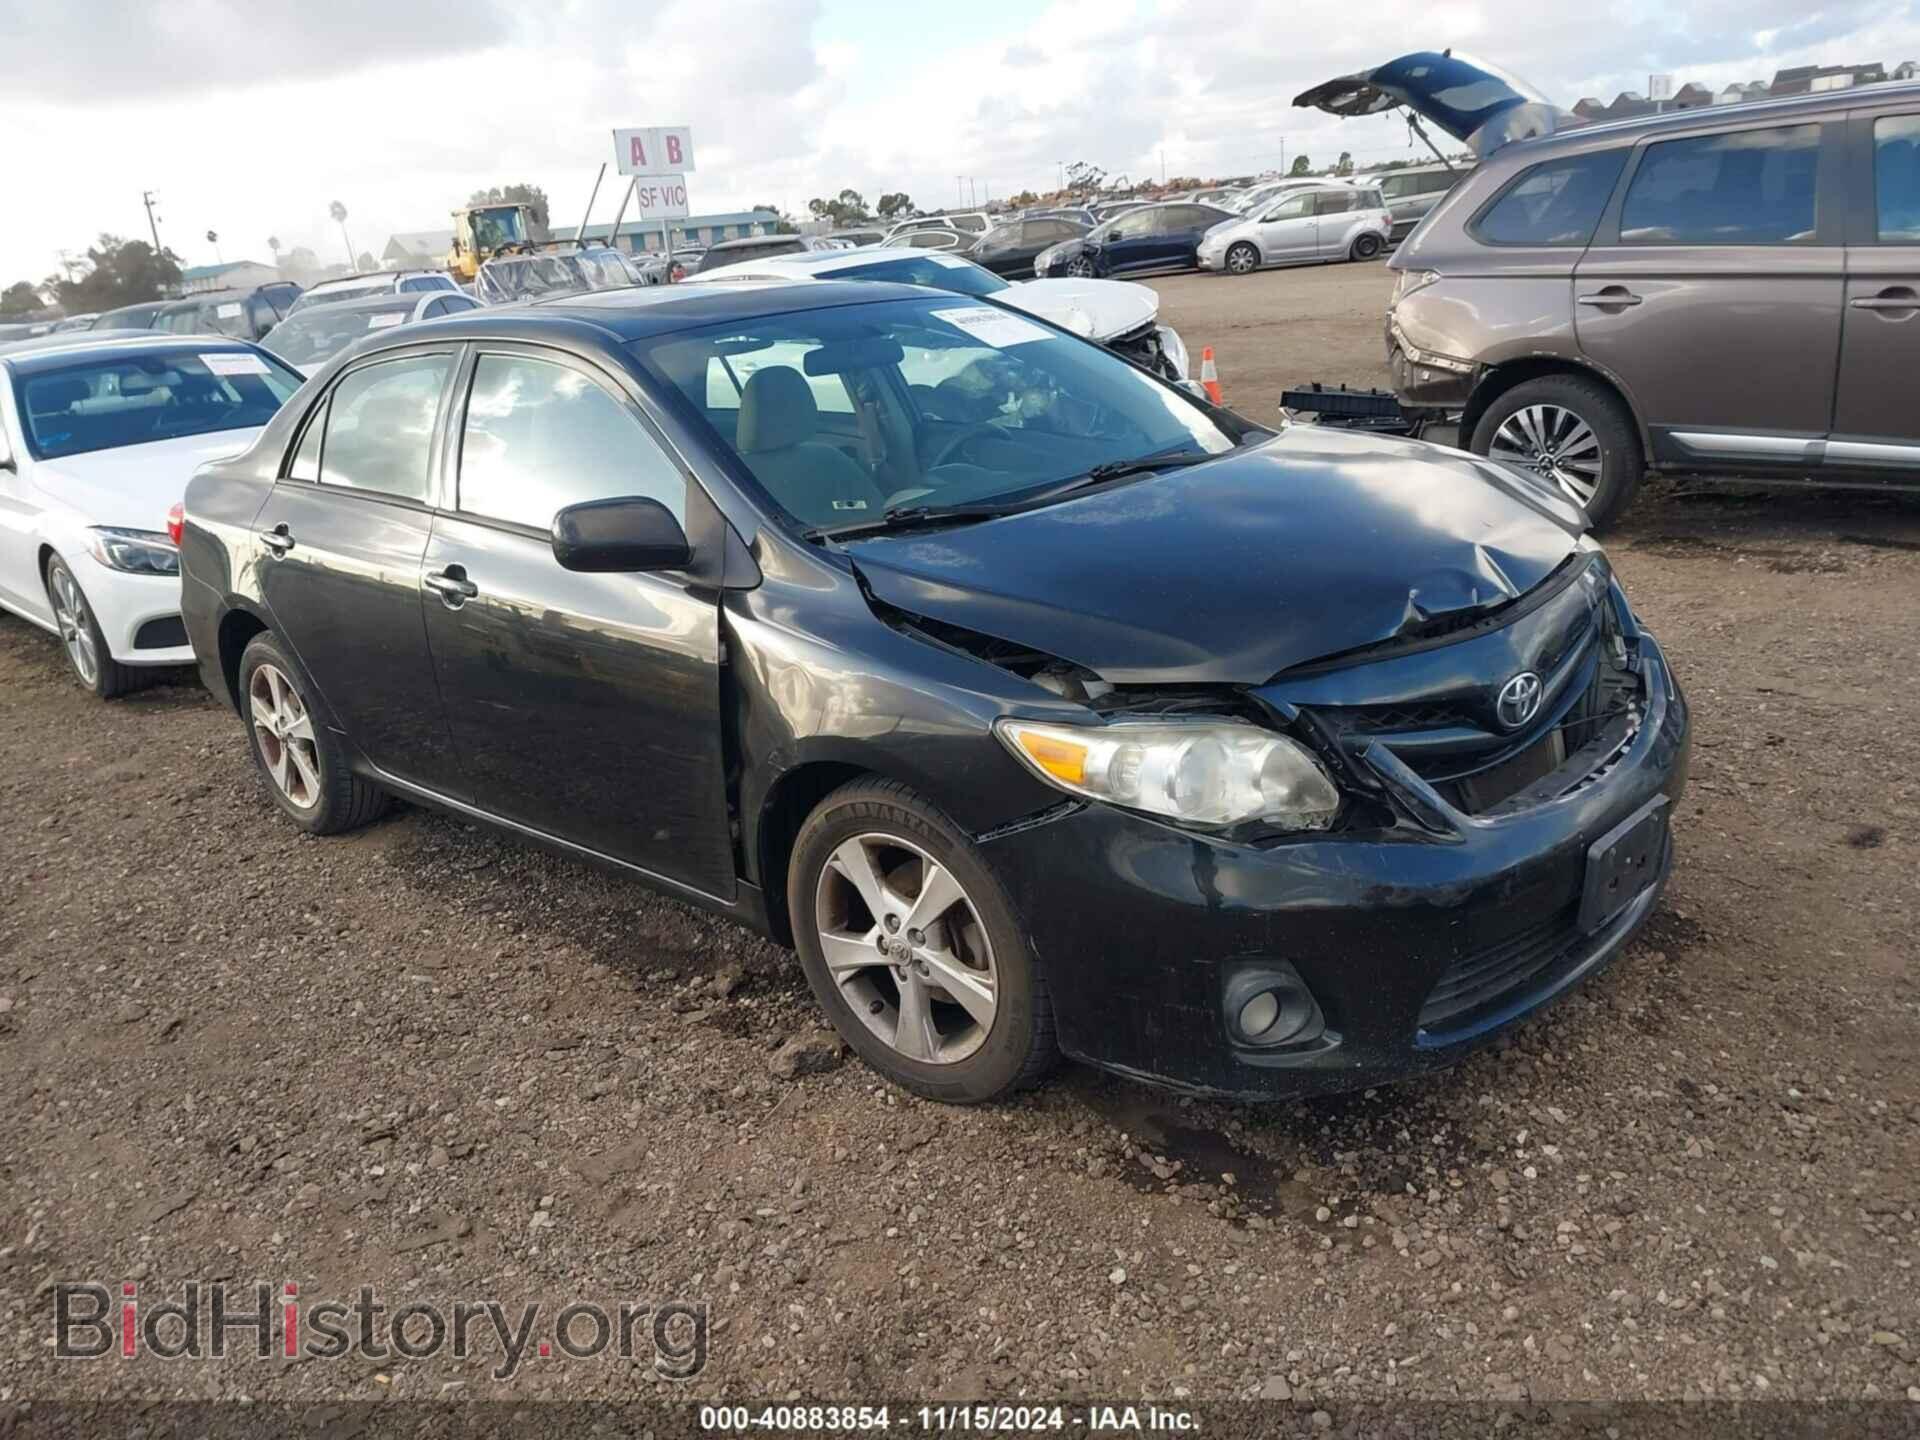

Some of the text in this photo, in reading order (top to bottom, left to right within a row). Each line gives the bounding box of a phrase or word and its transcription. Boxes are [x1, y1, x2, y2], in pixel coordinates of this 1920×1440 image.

[631, 135, 683, 166] A B
[640, 185, 685, 208] SF VIC
